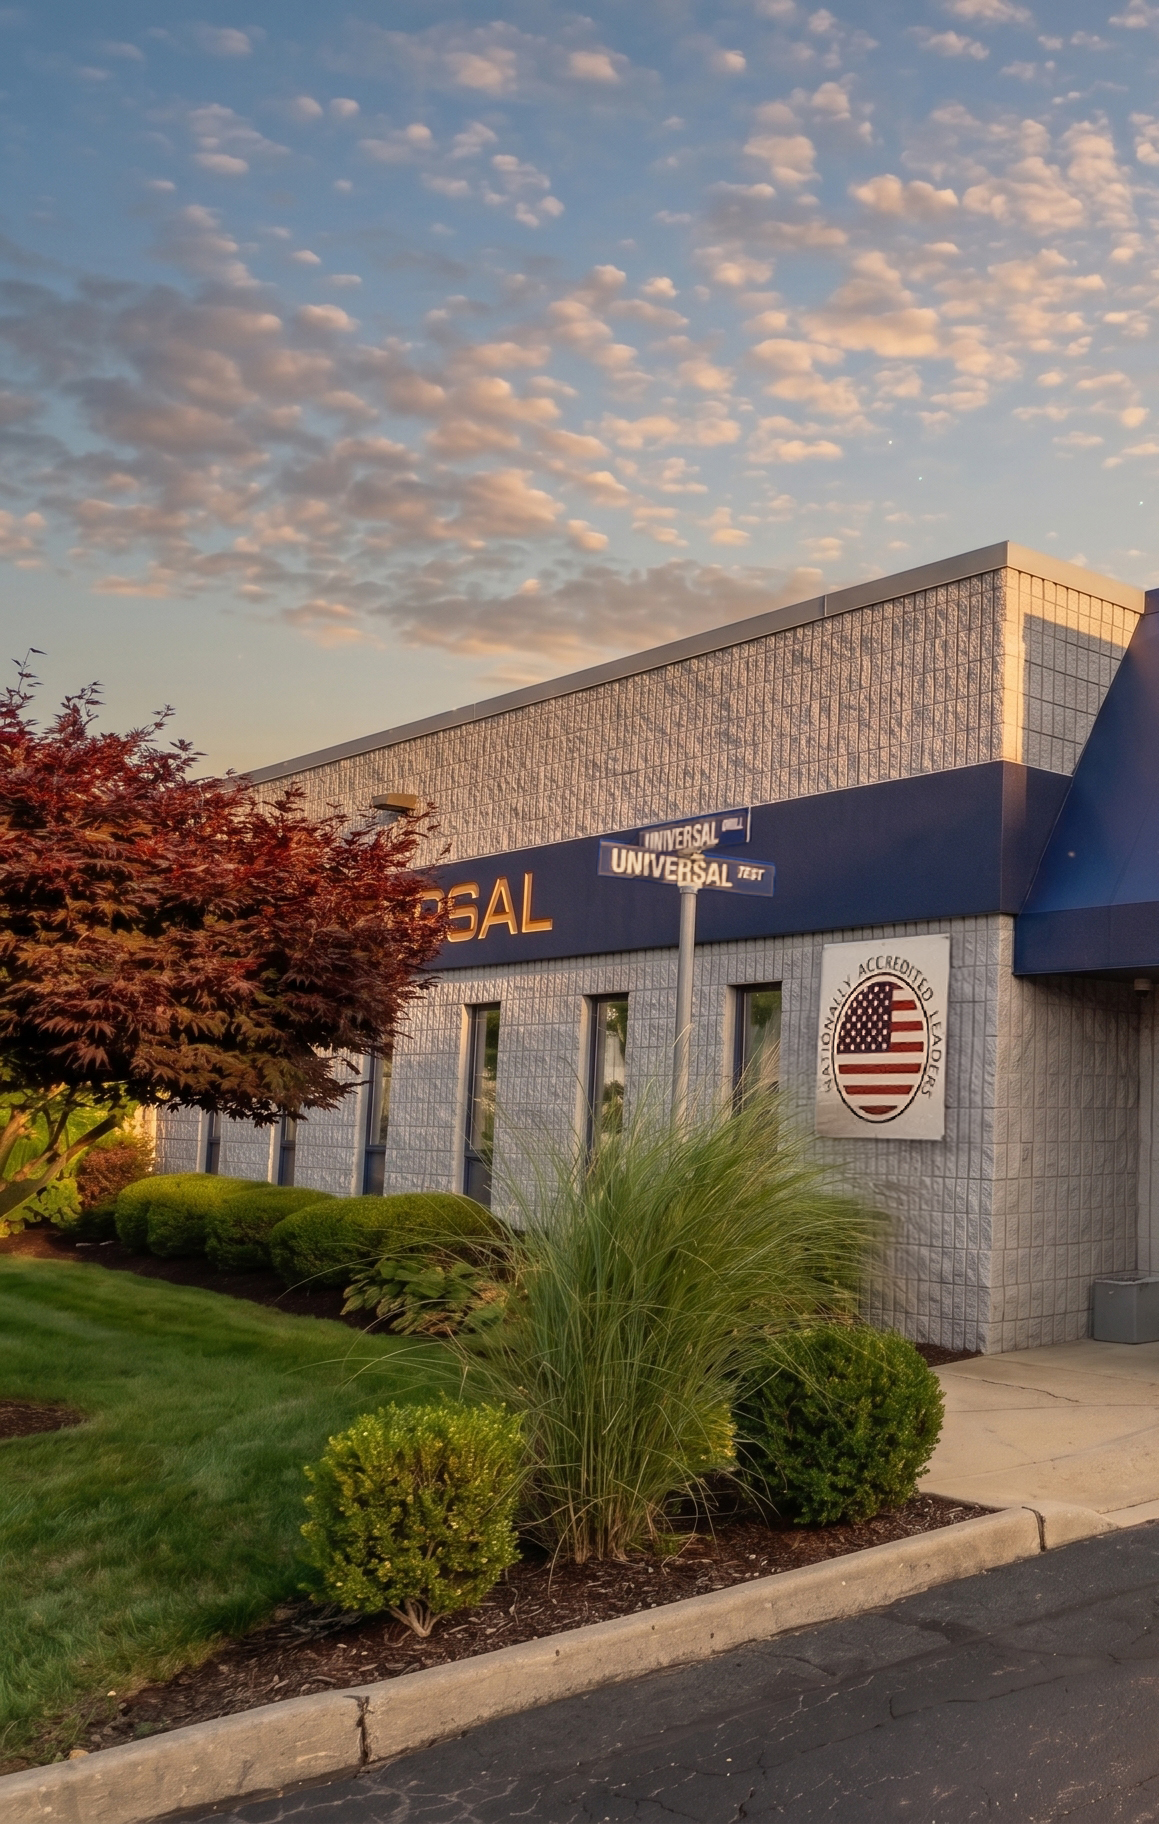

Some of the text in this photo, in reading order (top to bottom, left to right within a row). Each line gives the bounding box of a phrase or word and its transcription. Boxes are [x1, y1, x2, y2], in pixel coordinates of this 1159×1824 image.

[644, 821, 720, 852] UNIVERSAL
[611, 847, 734, 887] UNIVERSAL
[858, 955, 934, 1002] ACCREDITED
